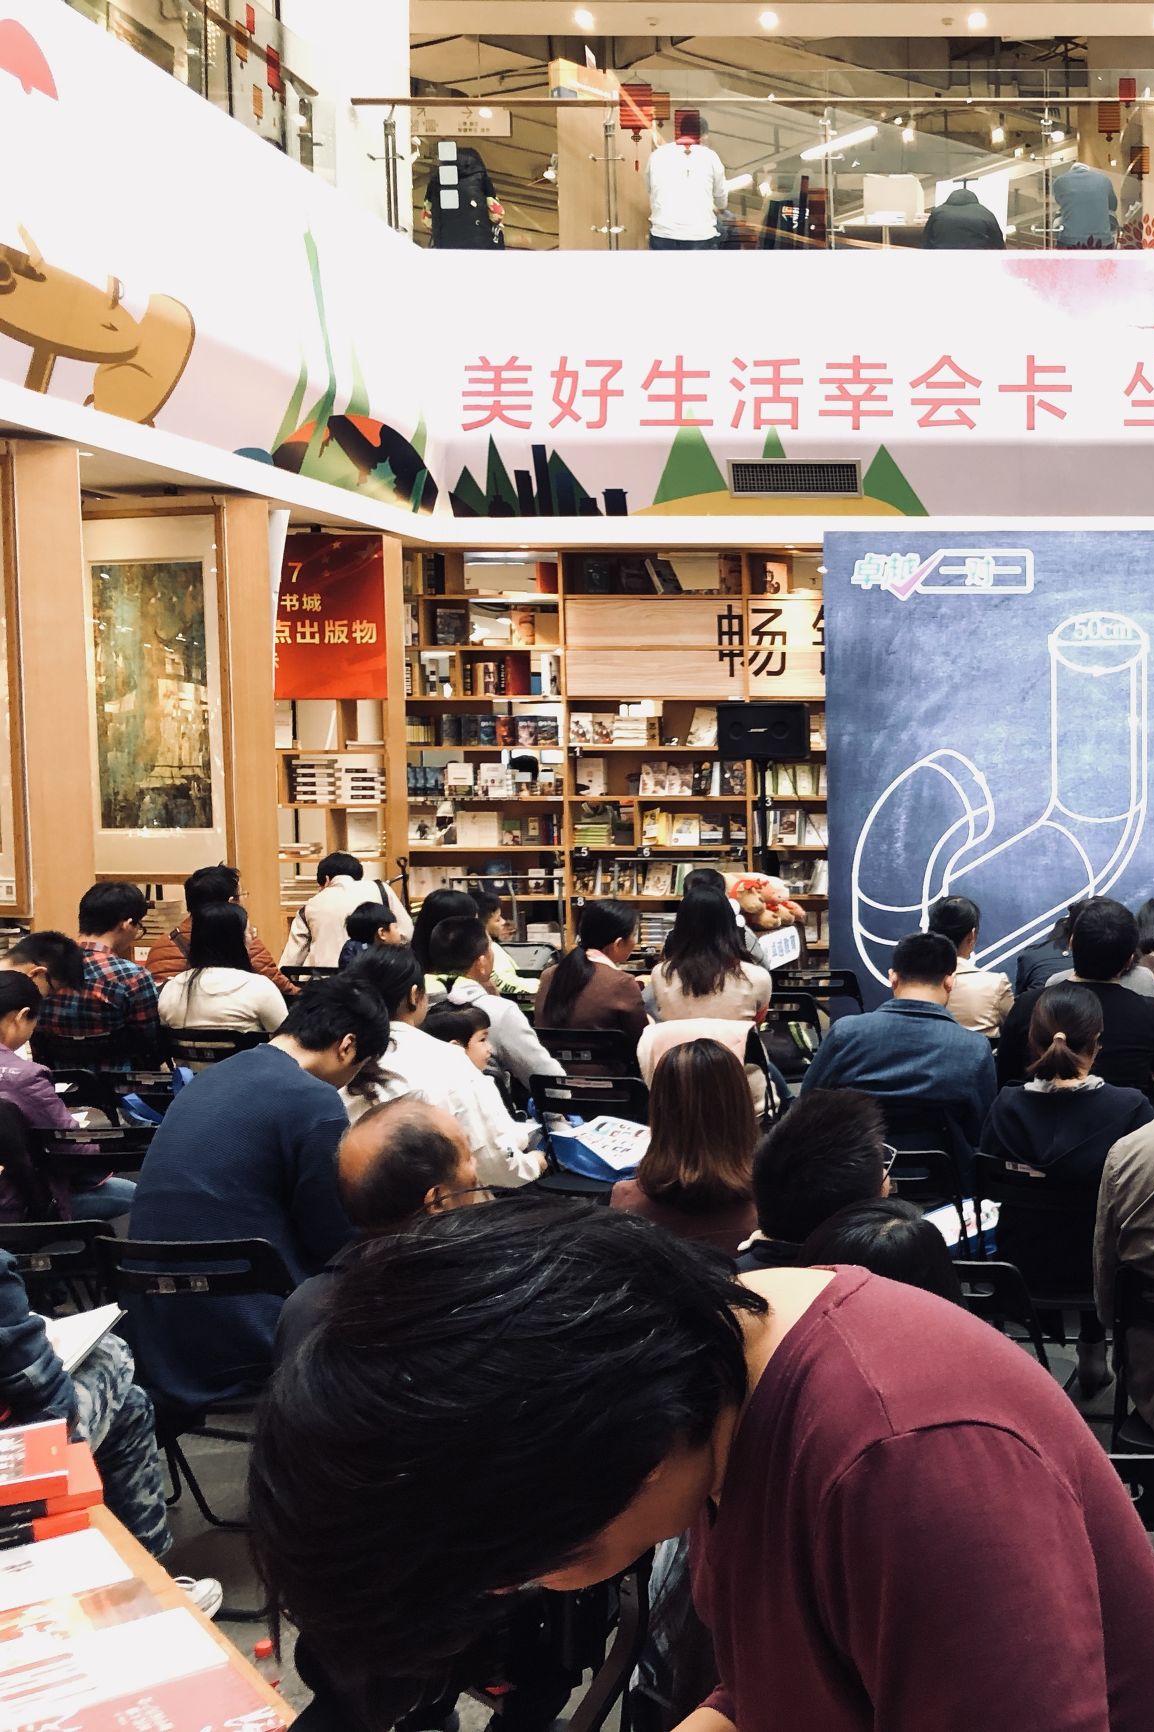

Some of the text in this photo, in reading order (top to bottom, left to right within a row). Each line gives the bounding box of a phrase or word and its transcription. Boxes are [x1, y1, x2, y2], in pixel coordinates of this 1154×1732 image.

[462, 354, 1072, 430] 美好生活幸会卡
[280, 593, 322, 612] 书城
[275, 619, 378, 645] 点出版物
[1073, 618, 1133, 641] 50cm
